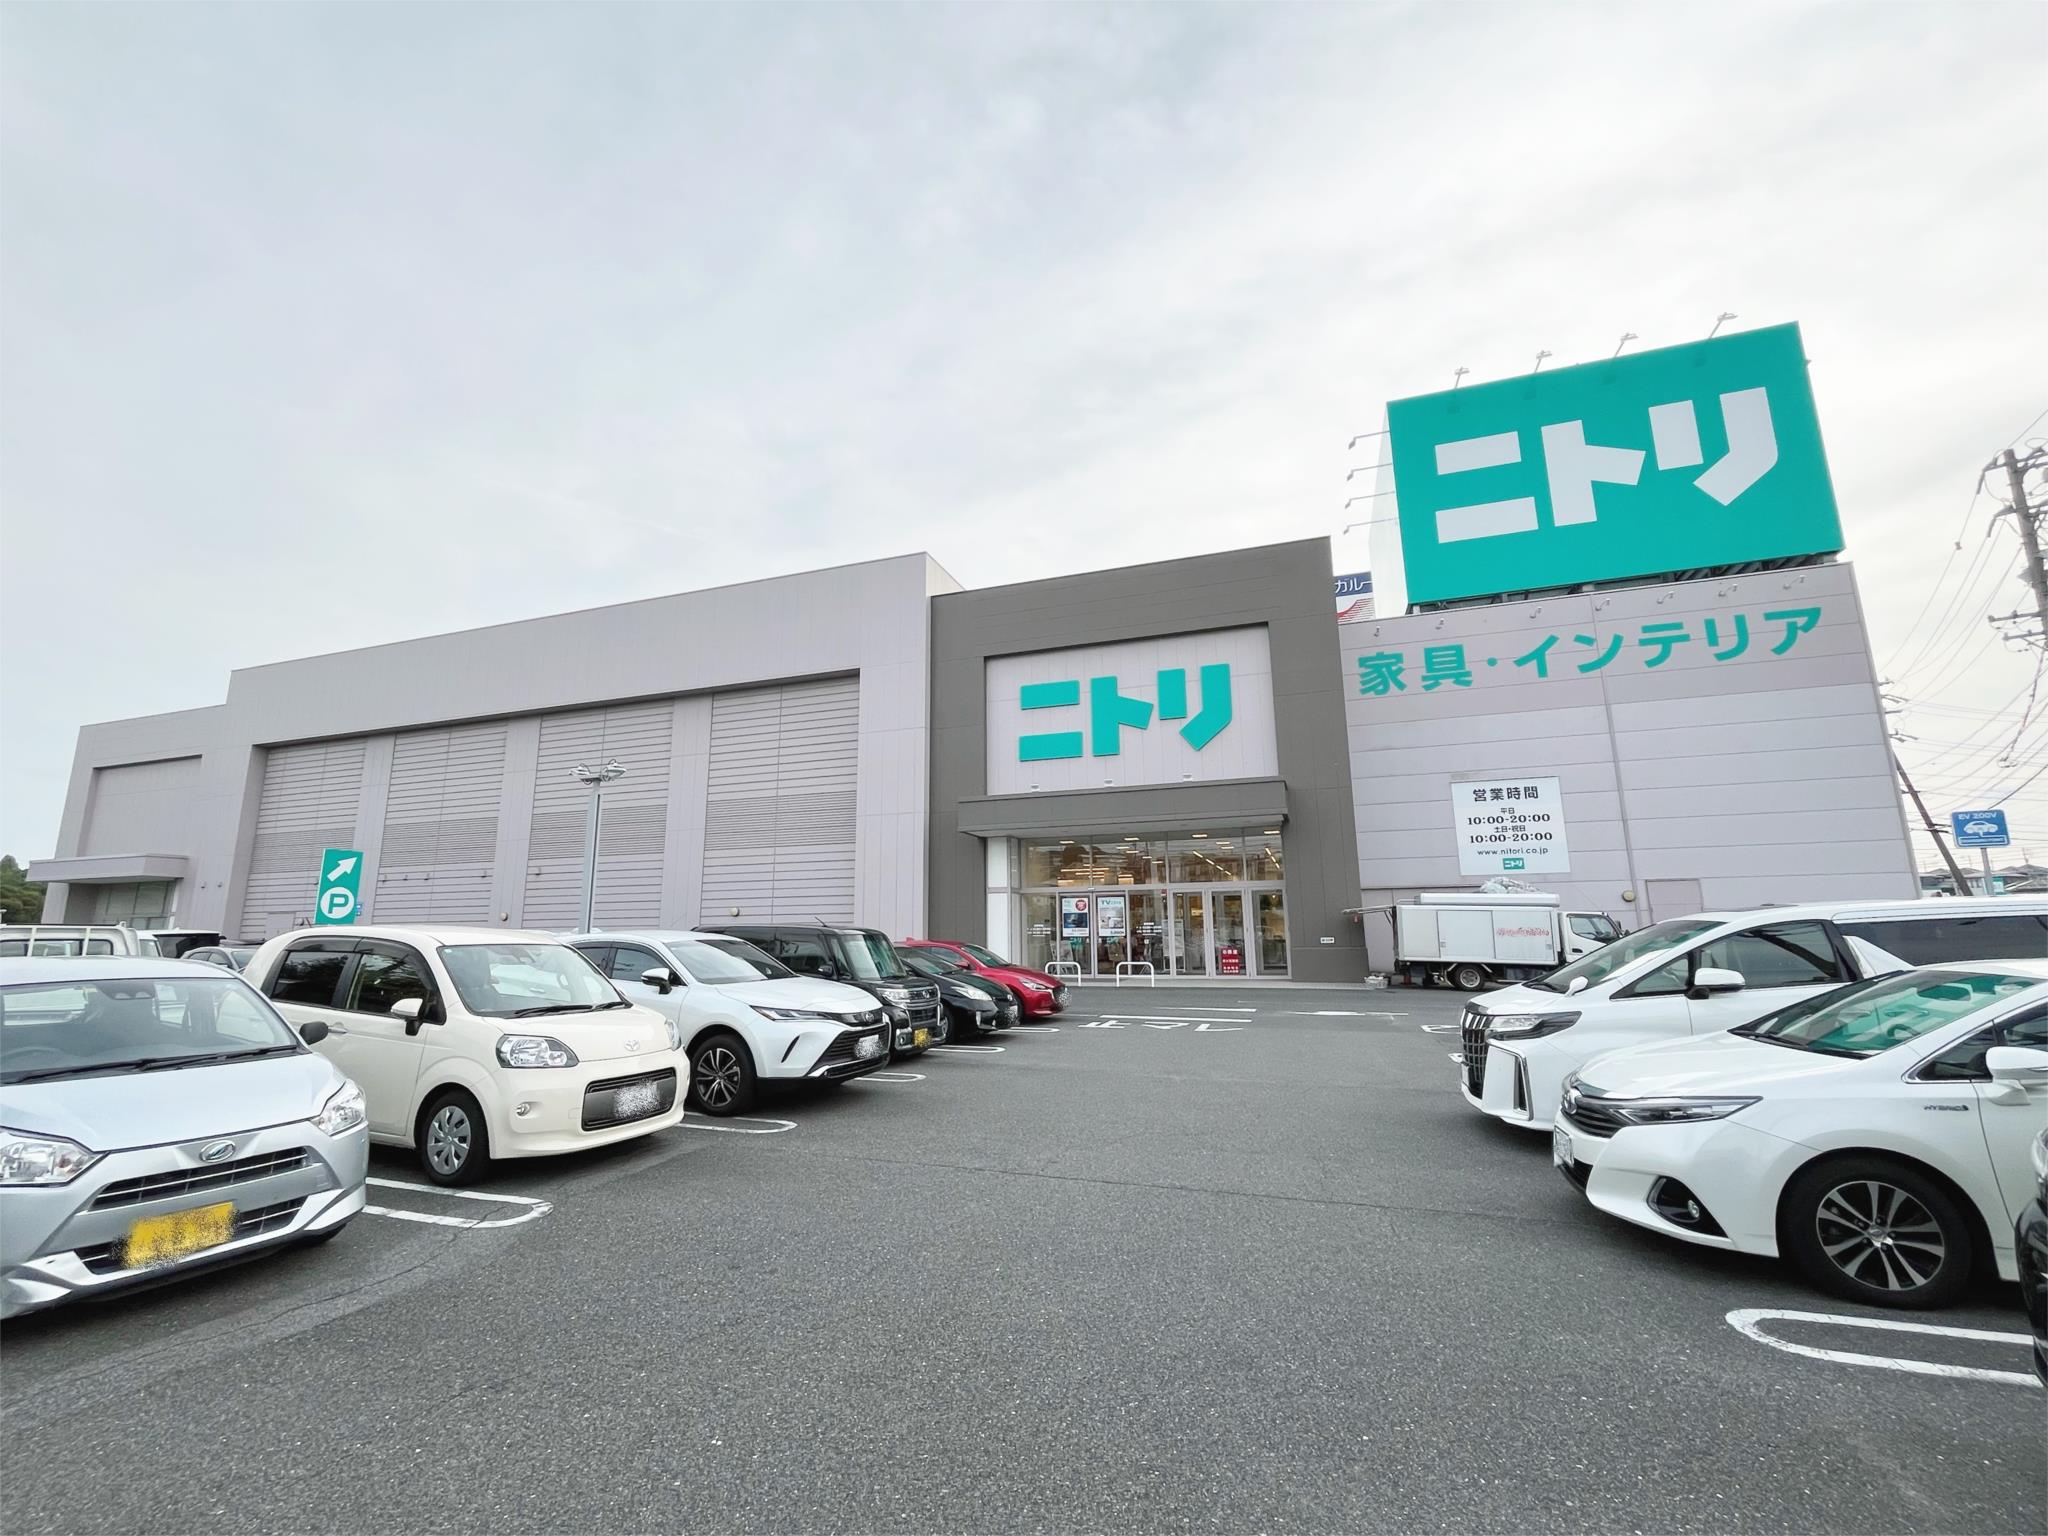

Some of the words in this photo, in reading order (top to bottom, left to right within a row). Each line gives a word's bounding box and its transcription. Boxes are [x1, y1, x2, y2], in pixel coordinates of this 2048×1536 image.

[1435, 386, 1779, 544] ニトリ
[1357, 606, 1822, 698] 家具・インテリア
[1018, 663, 1233, 762] ニトリ
[1473, 786, 1538, 801] 営業時間
[1477, 847, 1548, 855] www.nitori.co.jp
[1504, 859, 1523, 868] ニトリ
[328, 893, 350, 914] P
